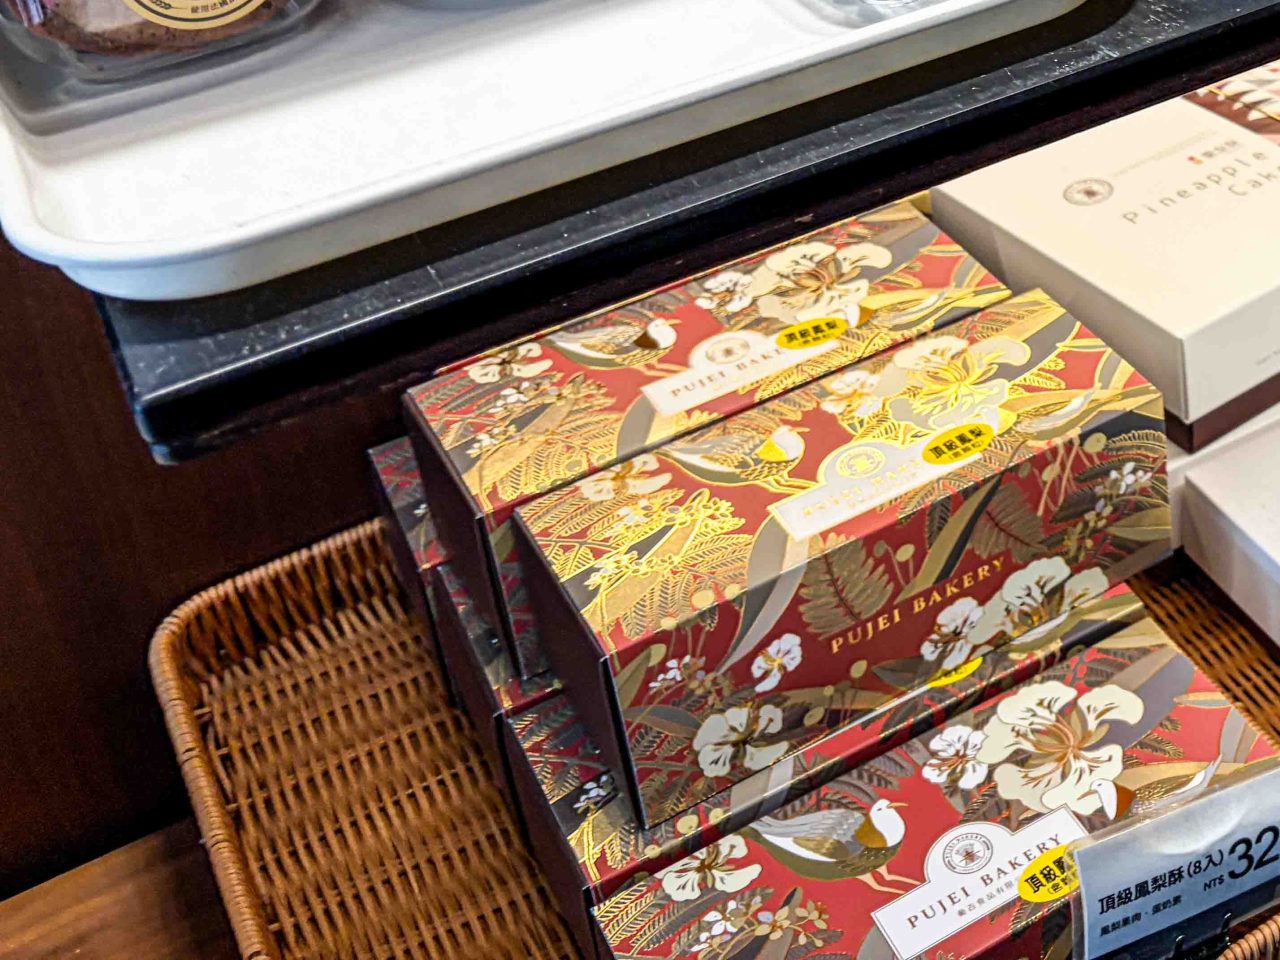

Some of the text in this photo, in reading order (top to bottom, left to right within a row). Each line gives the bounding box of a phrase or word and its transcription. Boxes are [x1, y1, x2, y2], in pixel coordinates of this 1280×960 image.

[1121, 150, 1267, 224] Pineapple
[831, 557, 1005, 654] PUJEI BAKERY
[906, 833, 1063, 929] PUJEI BAKERY
[1098, 849, 1224, 915] 頂級鳳梨酥(8入)
[1203, 874, 1225, 892] NT$
